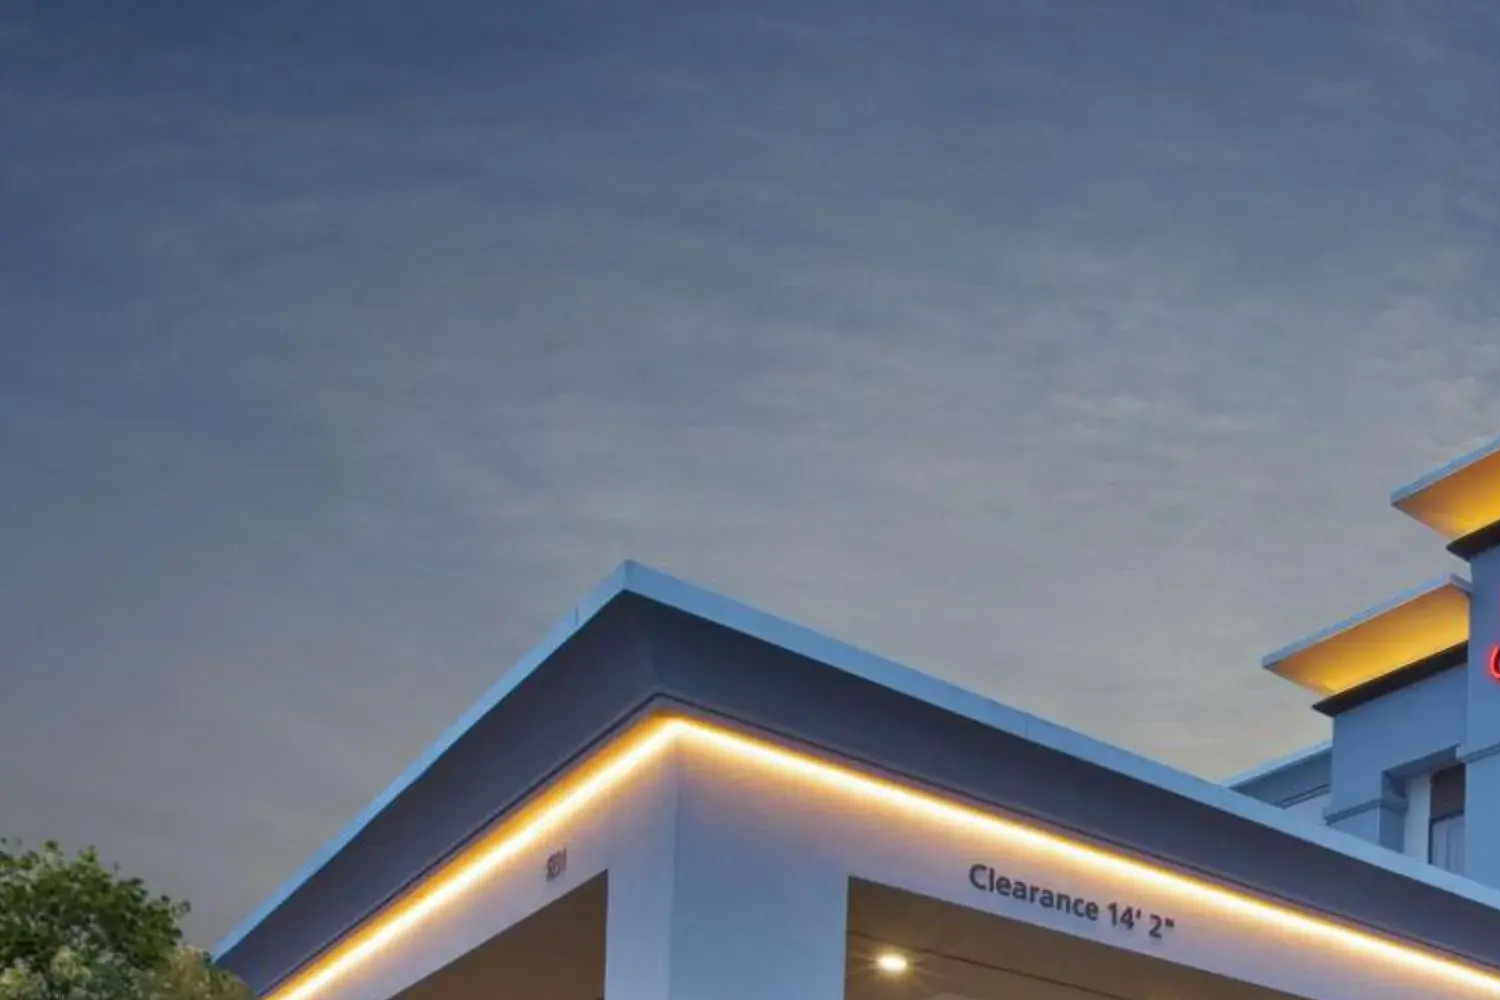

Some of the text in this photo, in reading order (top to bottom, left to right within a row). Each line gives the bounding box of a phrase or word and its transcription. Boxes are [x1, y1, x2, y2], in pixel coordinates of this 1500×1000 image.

[968, 863, 1176, 939] Clearance 14' 2"
